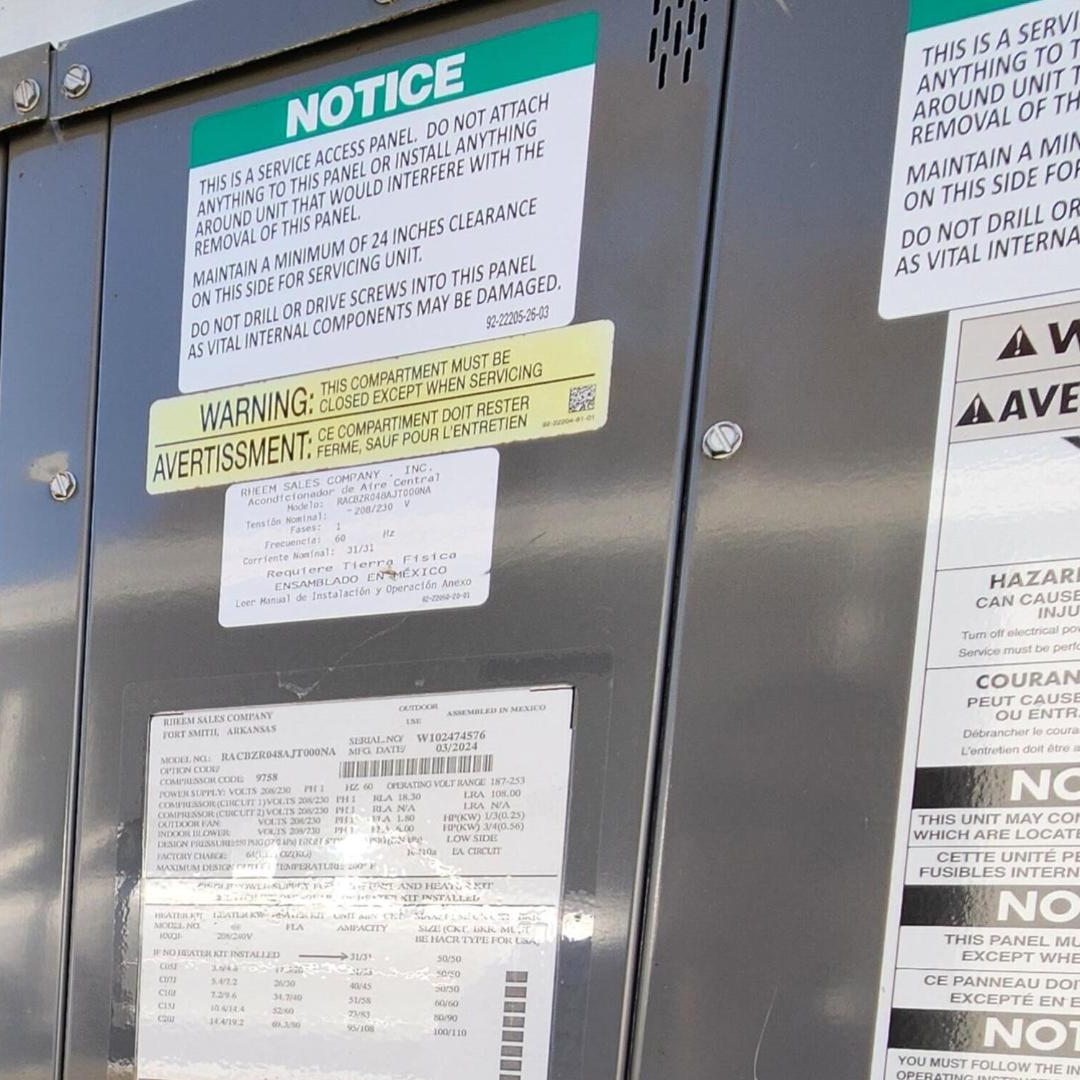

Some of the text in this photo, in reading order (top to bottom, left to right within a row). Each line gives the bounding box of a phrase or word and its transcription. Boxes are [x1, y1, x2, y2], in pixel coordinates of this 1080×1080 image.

[922, 38, 966, 67] THIS
[973, 32, 990, 56] IS
[995, 28, 1010, 50] A
[286, 52, 466, 138] NOTICE
[199, 92, 549, 195] THIS IS A SERVICE ACCESS PANEL. DO NOT ATTACH
[911, 106, 1011, 146] REMOVAL
[1018, 97, 1047, 122] OF
[194, 139, 544, 237] AROUND UNIT THAT WOULD INTERFERE WITH THE
[196, 119, 537, 217] ANYTHING TO THIS PANEL OR INSTALL ANYTHING
[193, 197, 537, 288] MAINTAIN A MINIMUM OF 24 INCHES CLEARANCE
[194, 204, 360, 257] REMOVAL OF THIS PANEL.
[901, 226, 931, 249] DO
[937, 215, 982, 243] NOT
[987, 204, 1044, 233] DRILL
[191, 245, 422, 308] ON THIS SIDE FOR SERVICING UNIT.
[894, 253, 920, 276] AS
[927, 243, 981, 270] VITAL
[187, 274, 561, 360] AS VITAL INTERNAL COMPONENTS MAY BE DAMAGED.
[191, 254, 536, 338] DO NOT DRILL OR DRIVE SCREWS INTO THIS PANEL
[486, 304, 550, 330] 92-22205-26-03
[319, 362, 542, 413] CLOSED EXCEPT WHEN SERVICING
[320, 349, 511, 395] THIS COMPARTMENT MUST BE
[200, 386, 314, 432] WARNING:
[317, 395, 529, 442] CE COMPARTIMENT DOIT RESTER
[152, 430, 312, 482] AVERTISSMENT:
[317, 439, 361, 458] FERME,
[365, 433, 399, 451] SAUF
[402, 427, 439, 445] POUR
[442, 413, 527, 439] L'ENTRETIEN
[435, 741, 477, 753] 03/2024
[936, 849, 1056, 863] CETTE UNITÉ
[943, 934, 1050, 946] THIS PANEL
